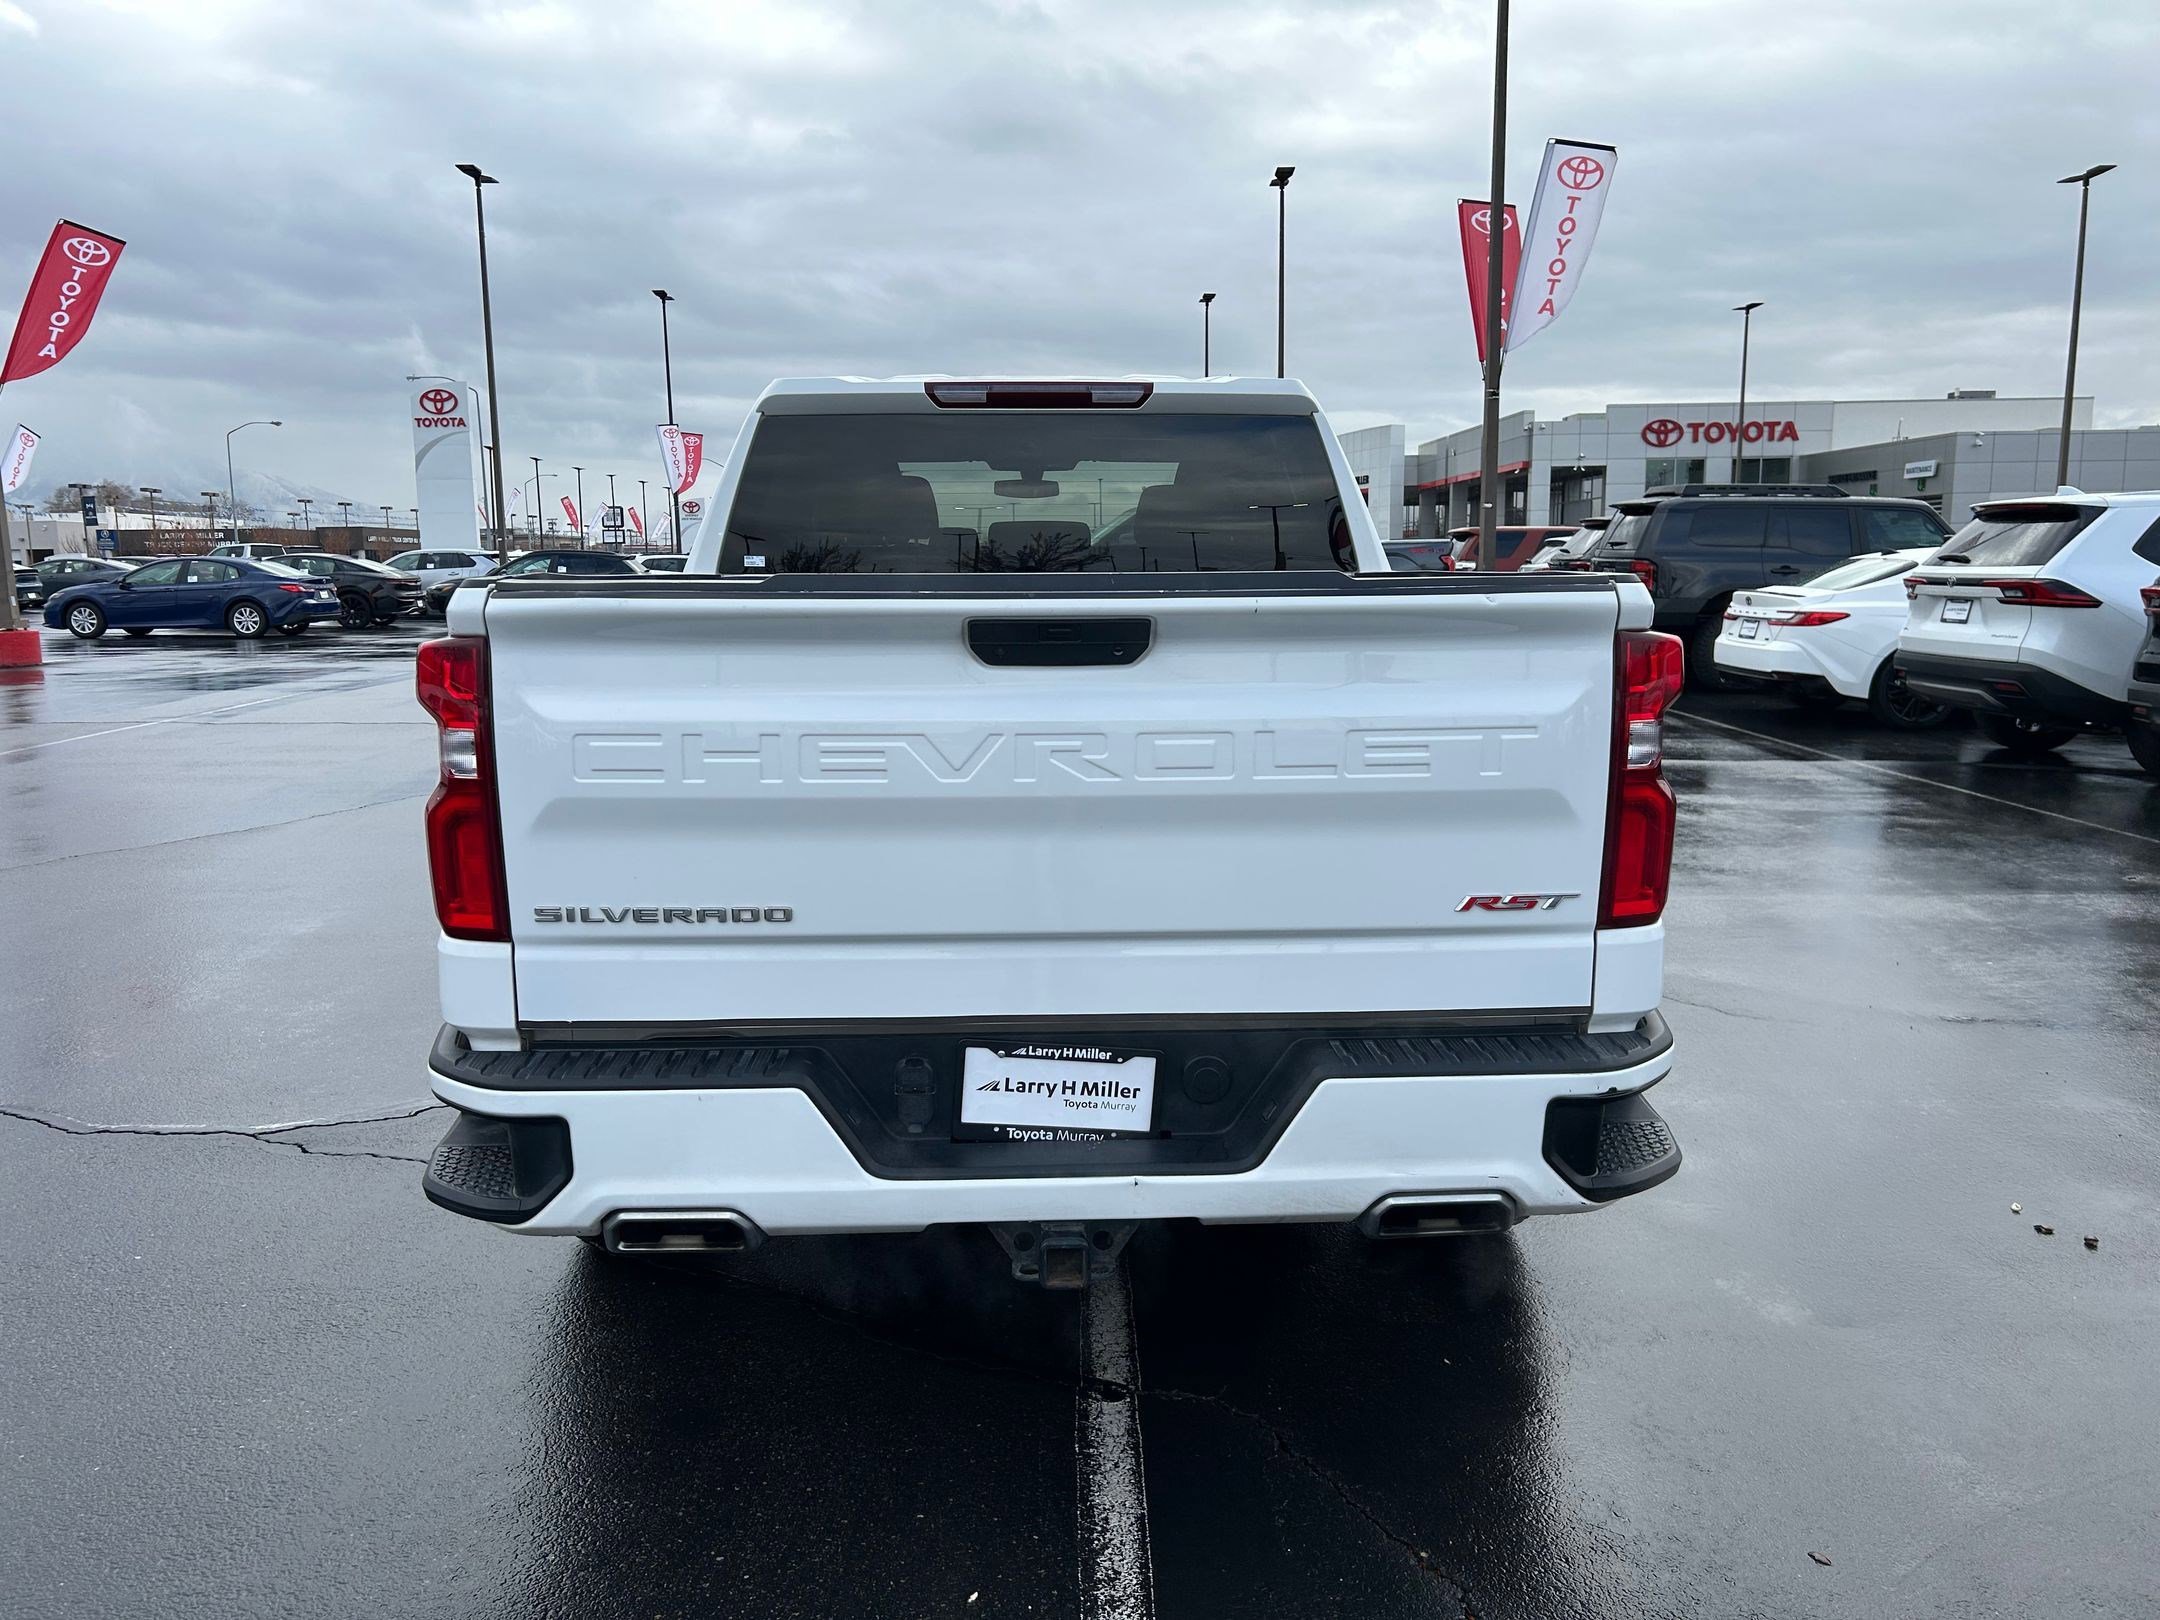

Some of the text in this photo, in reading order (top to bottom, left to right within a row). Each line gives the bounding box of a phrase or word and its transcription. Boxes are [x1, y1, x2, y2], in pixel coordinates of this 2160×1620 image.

[1537, 196, 1581, 316] TOYOTA
[38, 266, 87, 358] TOYOTA
[414, 417, 467, 428] TOYOTA
[1687, 421, 1799, 443] TOYOTA
[8, 446, 26, 488] TOYOTA
[670, 440, 683, 479] TOYOTA
[572, 726, 1539, 783] CHEVROLET
[1454, 891, 1581, 912] RST
[534, 905, 793, 923] SILVERADO
[1028, 1045, 1112, 1060] Larry H Miller
[1004, 1077, 1141, 1099] Larry H Miller
[1063, 1099, 1136, 1112] Toyota Murray
[1006, 1128, 1104, 1142] Toyota Murray
